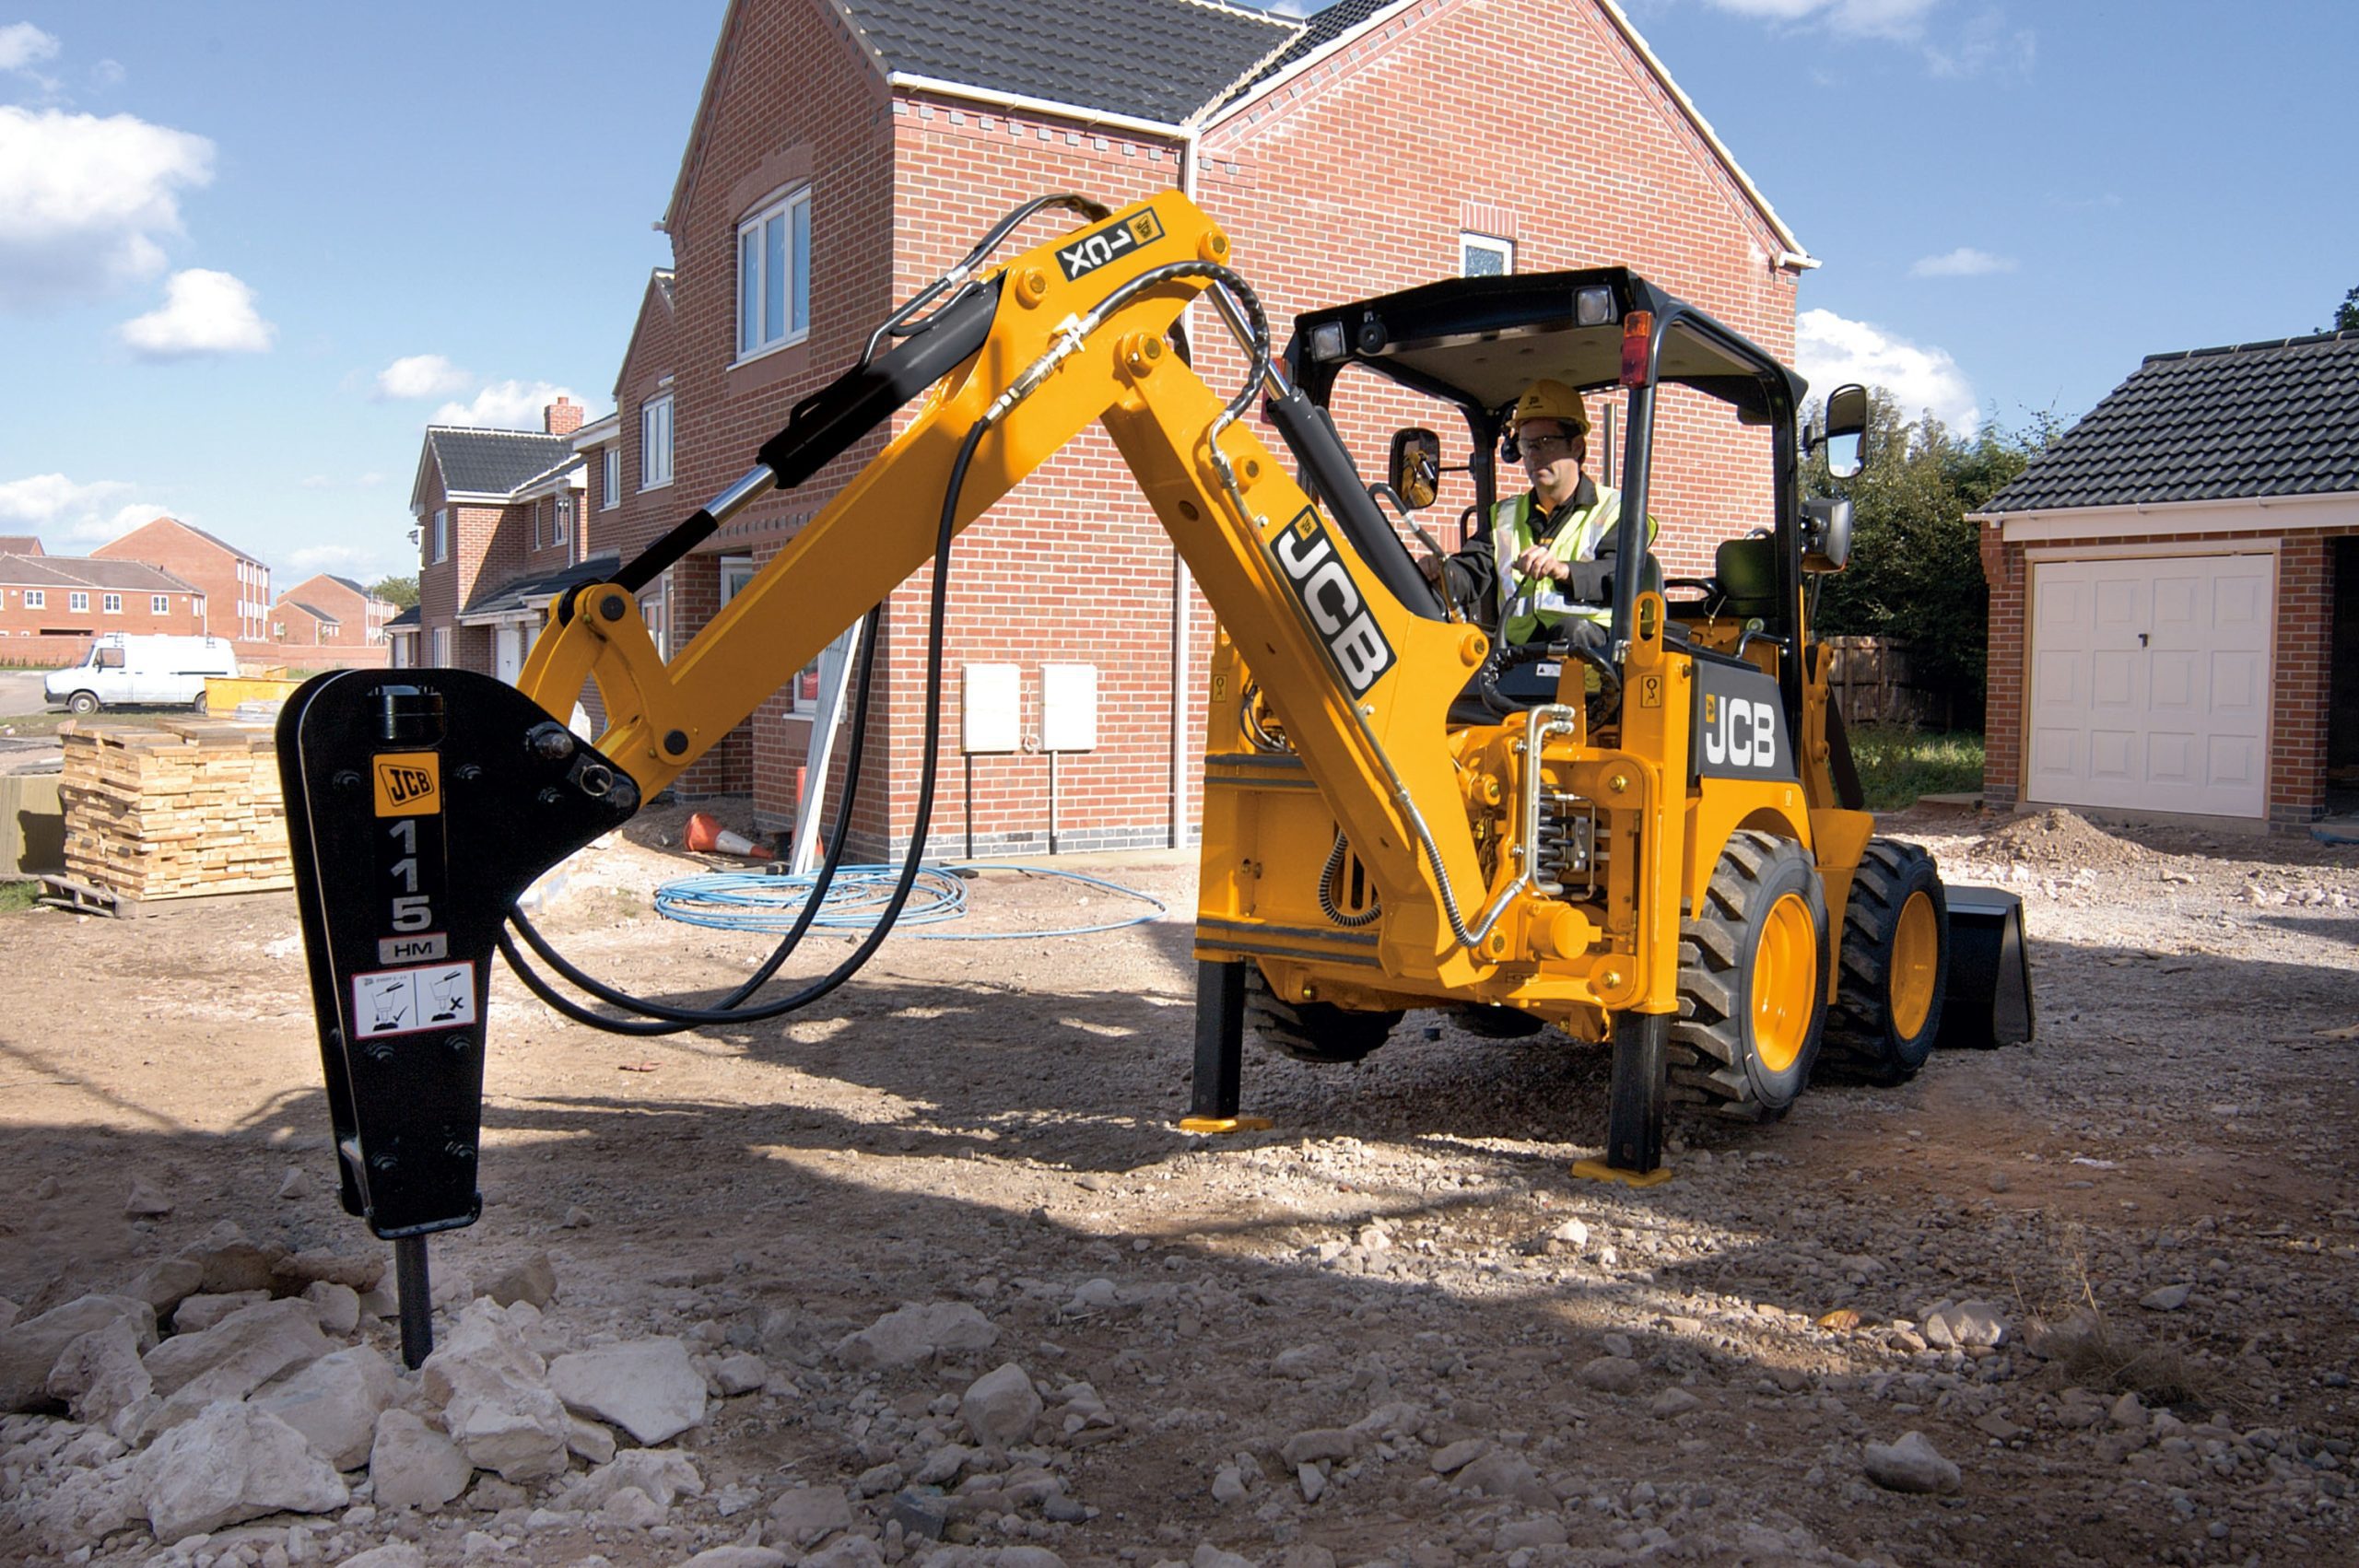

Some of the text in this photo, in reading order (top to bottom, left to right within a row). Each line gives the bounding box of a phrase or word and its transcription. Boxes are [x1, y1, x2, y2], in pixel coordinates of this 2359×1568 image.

[1062, 228, 1132, 277] 1CX
[1277, 531, 1389, 690] JCB
[1706, 696, 1776, 767] JCB
[389, 768, 431, 802] JCB
[394, 942, 432, 957] HM
